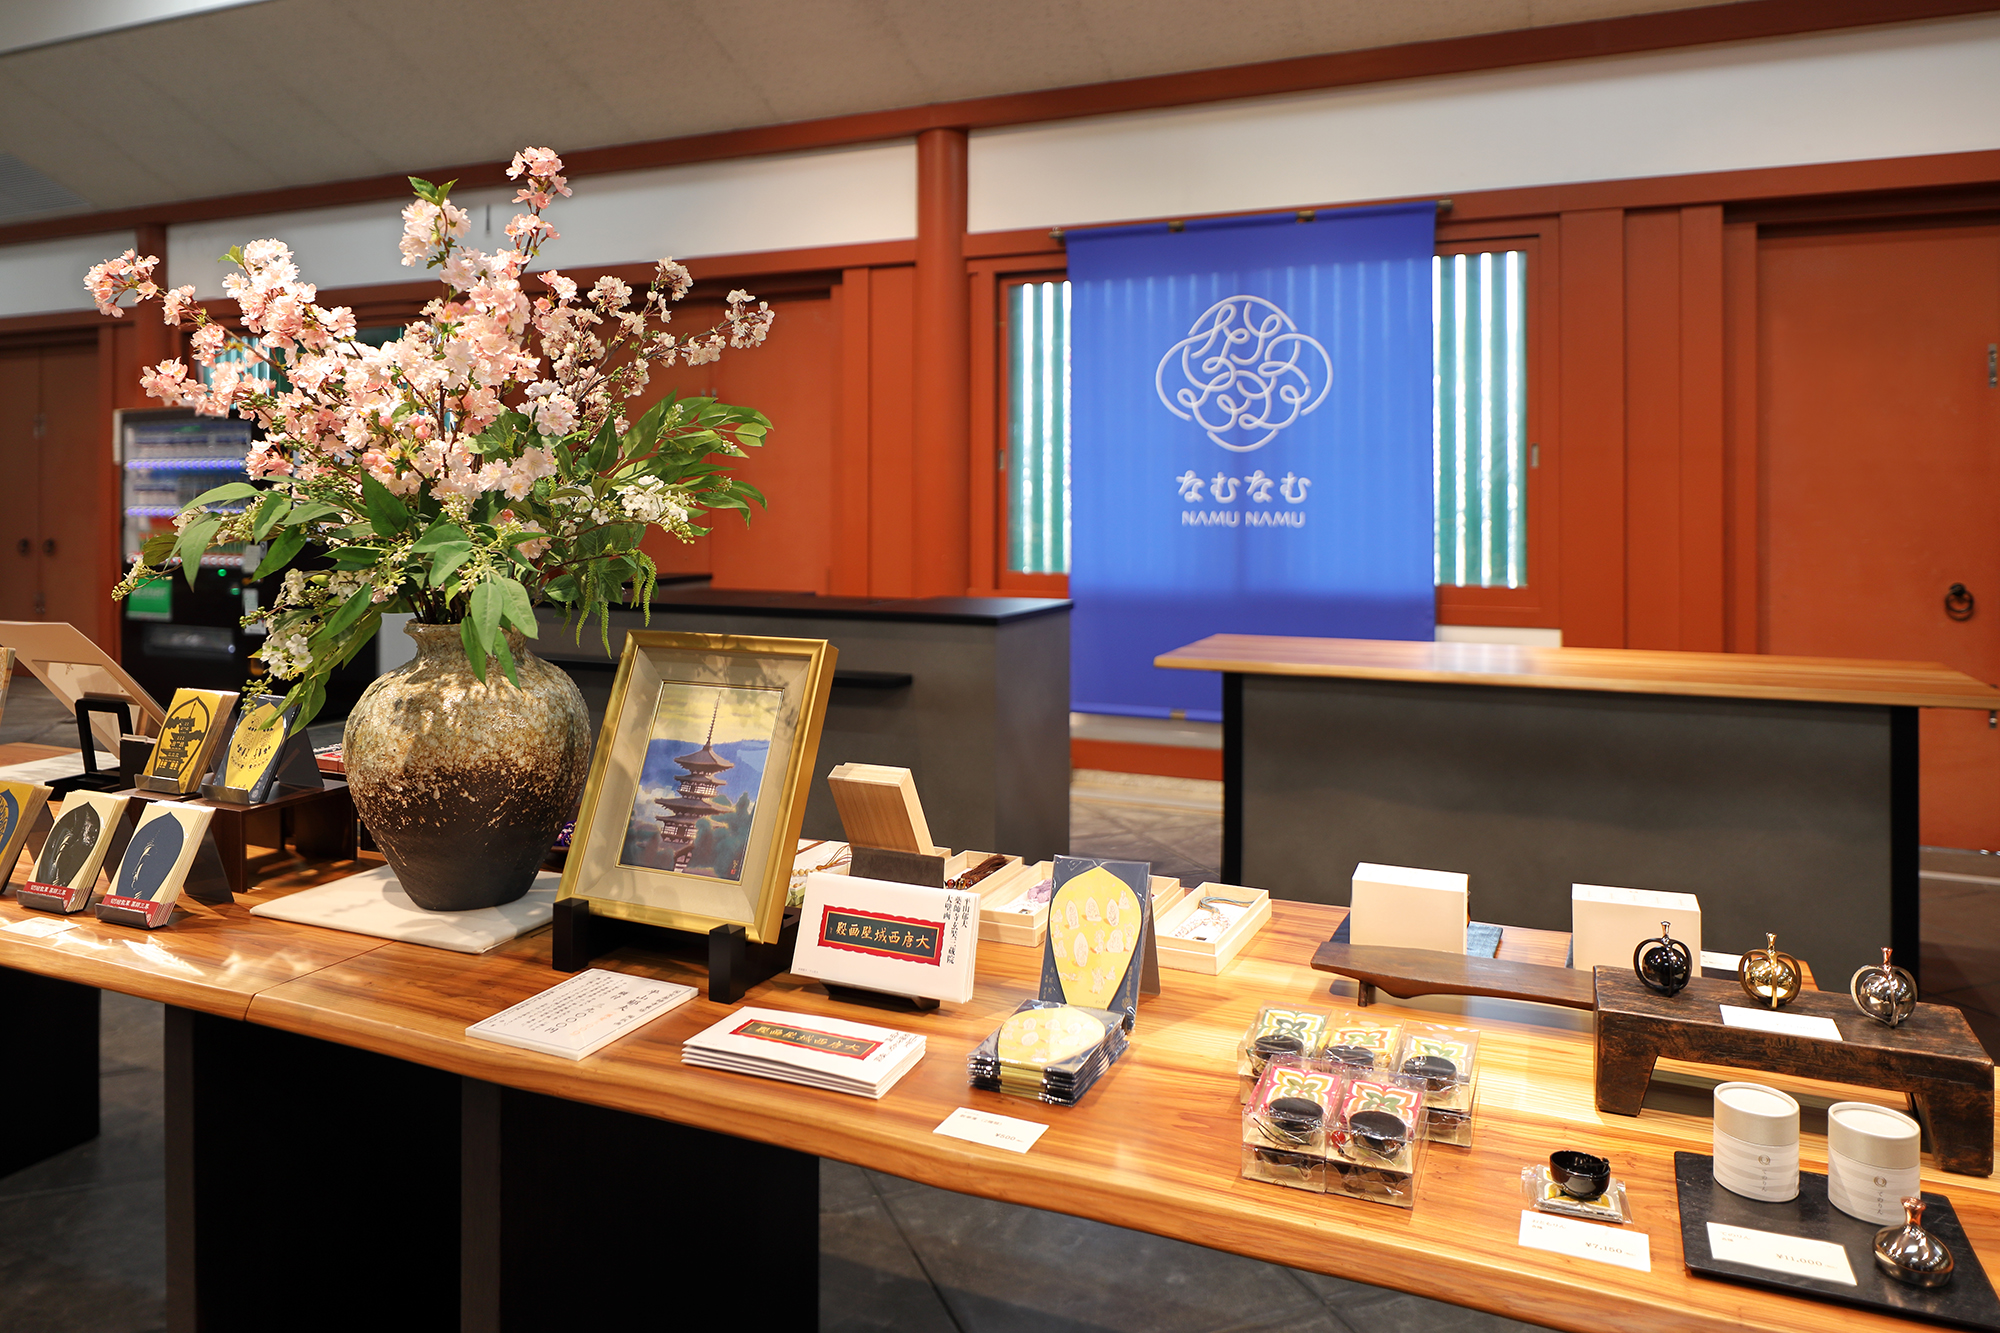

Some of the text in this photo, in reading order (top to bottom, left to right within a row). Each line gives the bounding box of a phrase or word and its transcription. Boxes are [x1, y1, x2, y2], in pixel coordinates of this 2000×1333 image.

[1176, 469, 1313, 504] なむなむ
[1181, 510, 1306, 528] NAMU NAMU
[1584, 1241, 1623, 1254] ¥7,150
[1775, 1252, 1823, 1267] ¥11,000
